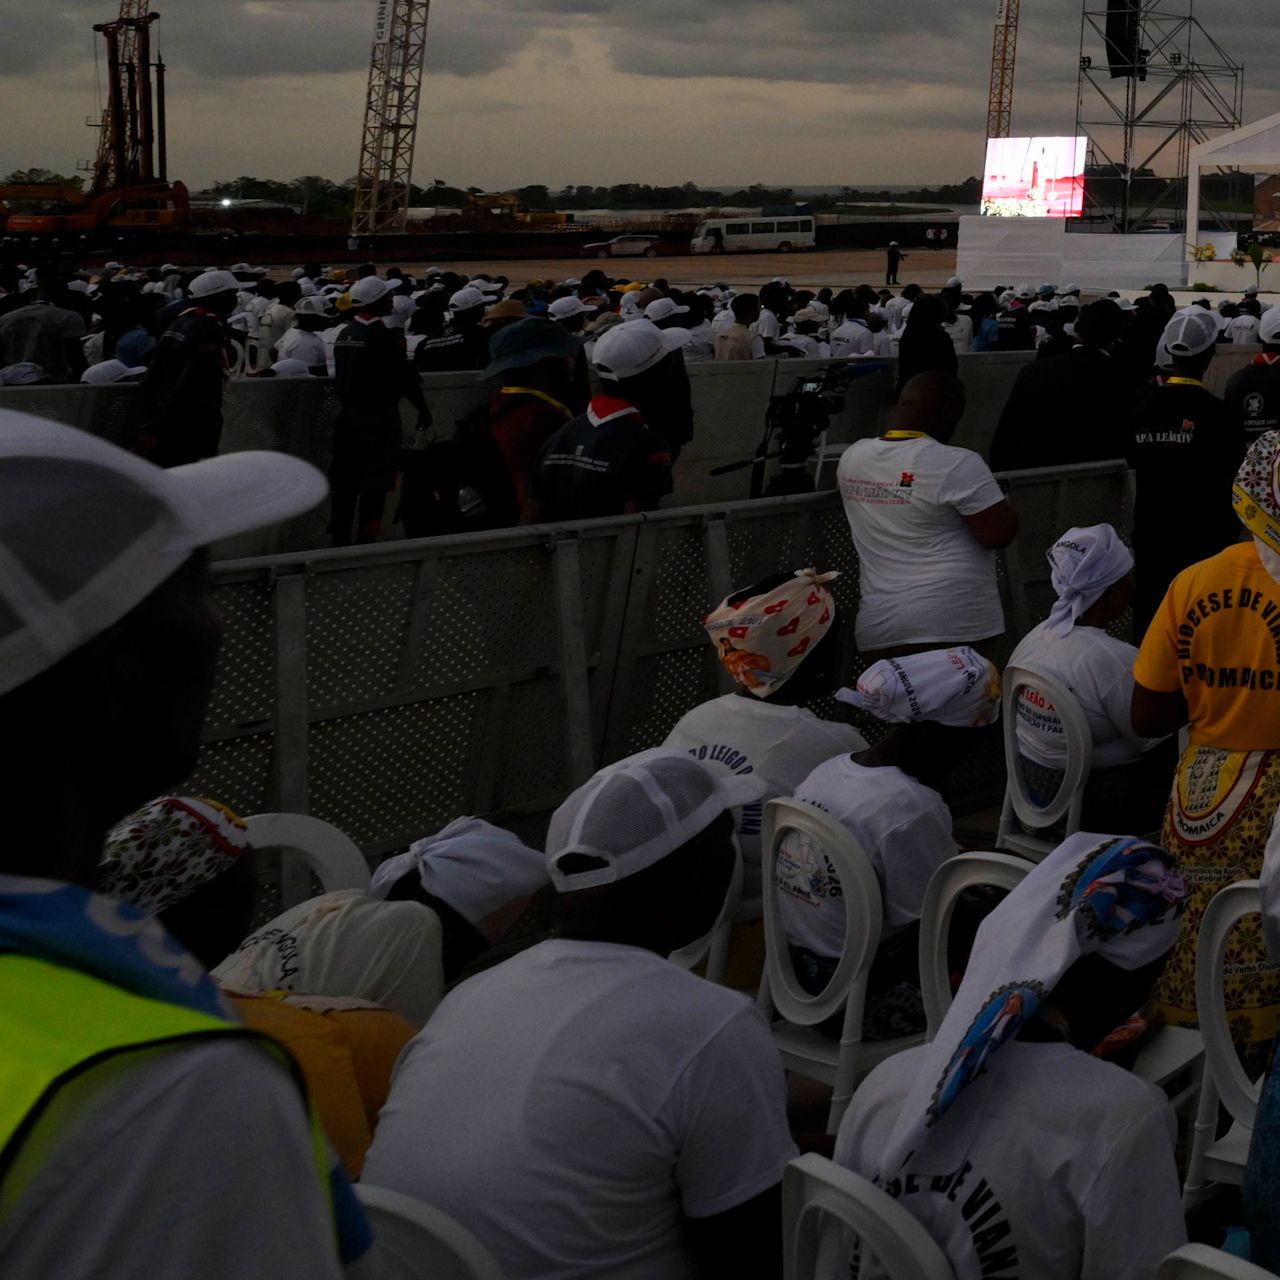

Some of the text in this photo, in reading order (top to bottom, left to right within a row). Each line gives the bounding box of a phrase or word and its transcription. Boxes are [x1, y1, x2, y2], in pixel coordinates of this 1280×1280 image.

[1177, 588, 1233, 660] DIOCESE
[1238, 587, 1263, 612] DE
[1026, 687, 1046, 709] LEÃO
[709, 744, 748, 770] LEIGO
[1175, 810, 1225, 836] PROMAICA
[1257, 962, 1280, 972] Divin
